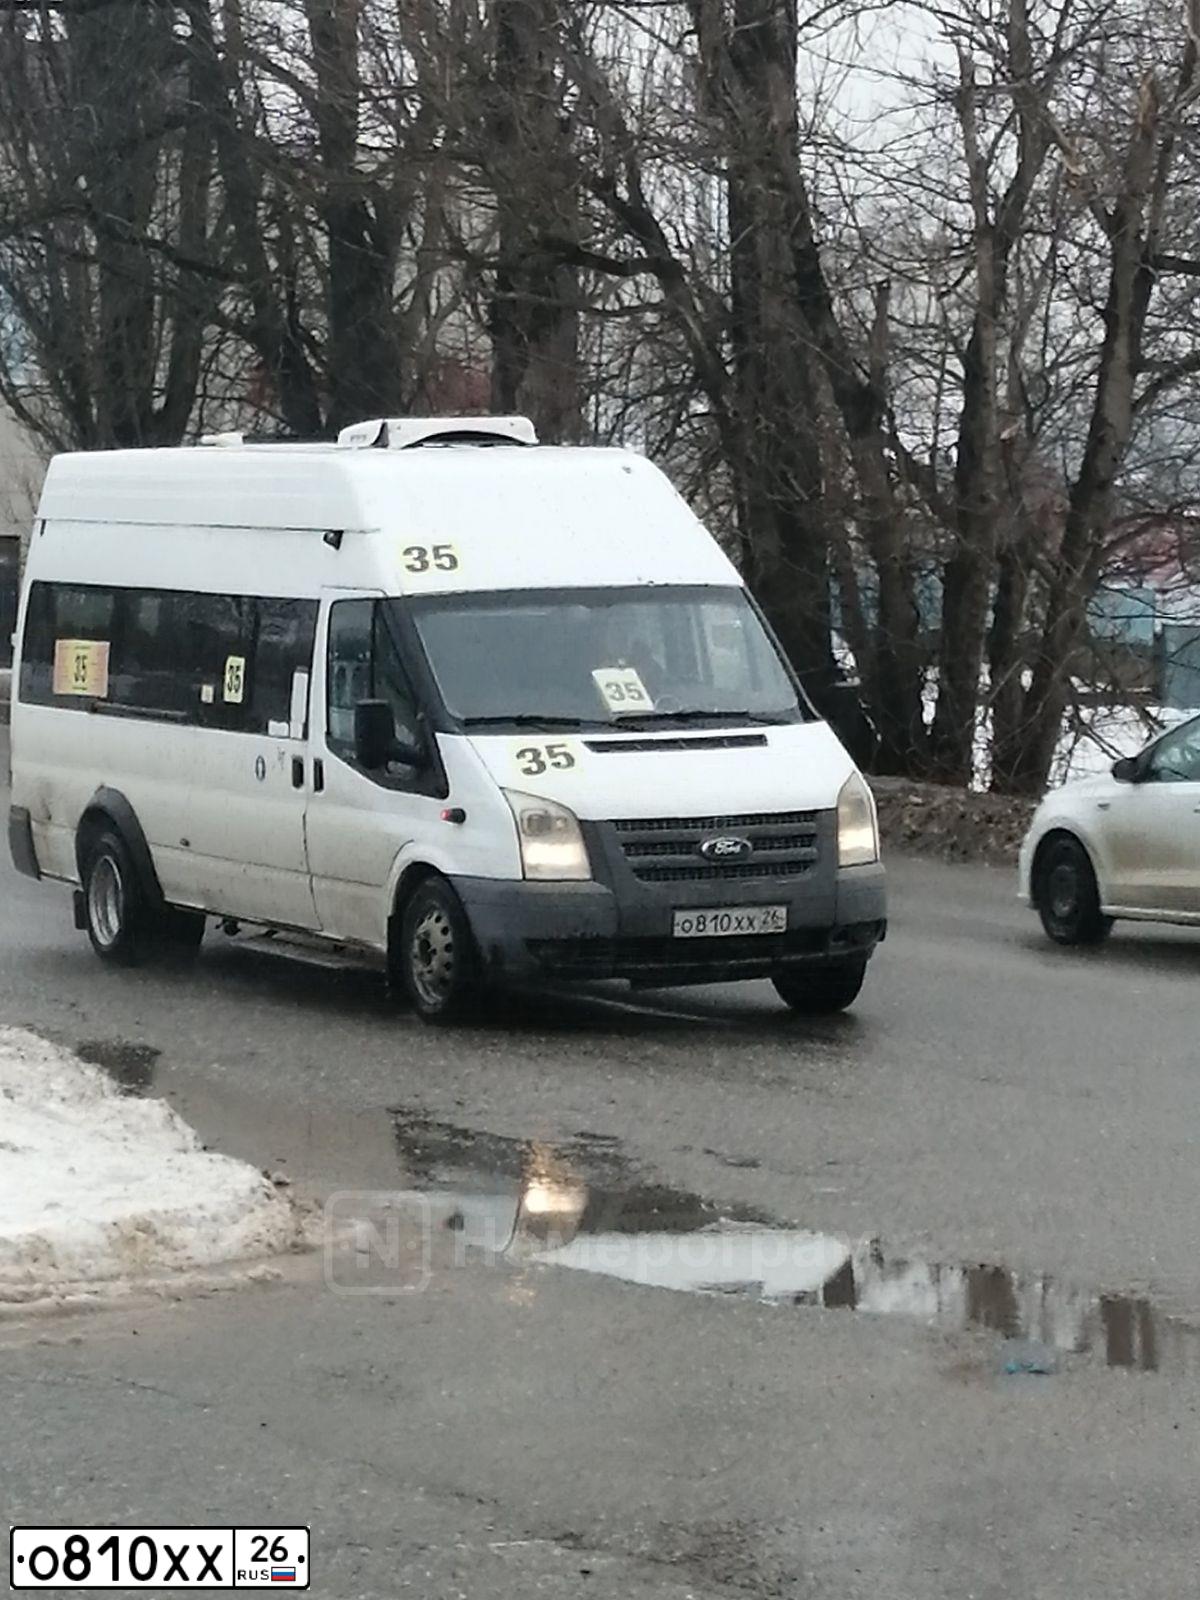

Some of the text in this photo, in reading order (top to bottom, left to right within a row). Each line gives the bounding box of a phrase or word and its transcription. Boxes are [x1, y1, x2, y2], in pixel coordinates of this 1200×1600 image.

[402, 544, 459, 573] 35
[74, 653, 88, 683] 35
[226, 664, 241, 693] 35
[605, 681, 646, 702] 35
[516, 743, 576, 776] 35
[714, 841, 741, 854] Ford
